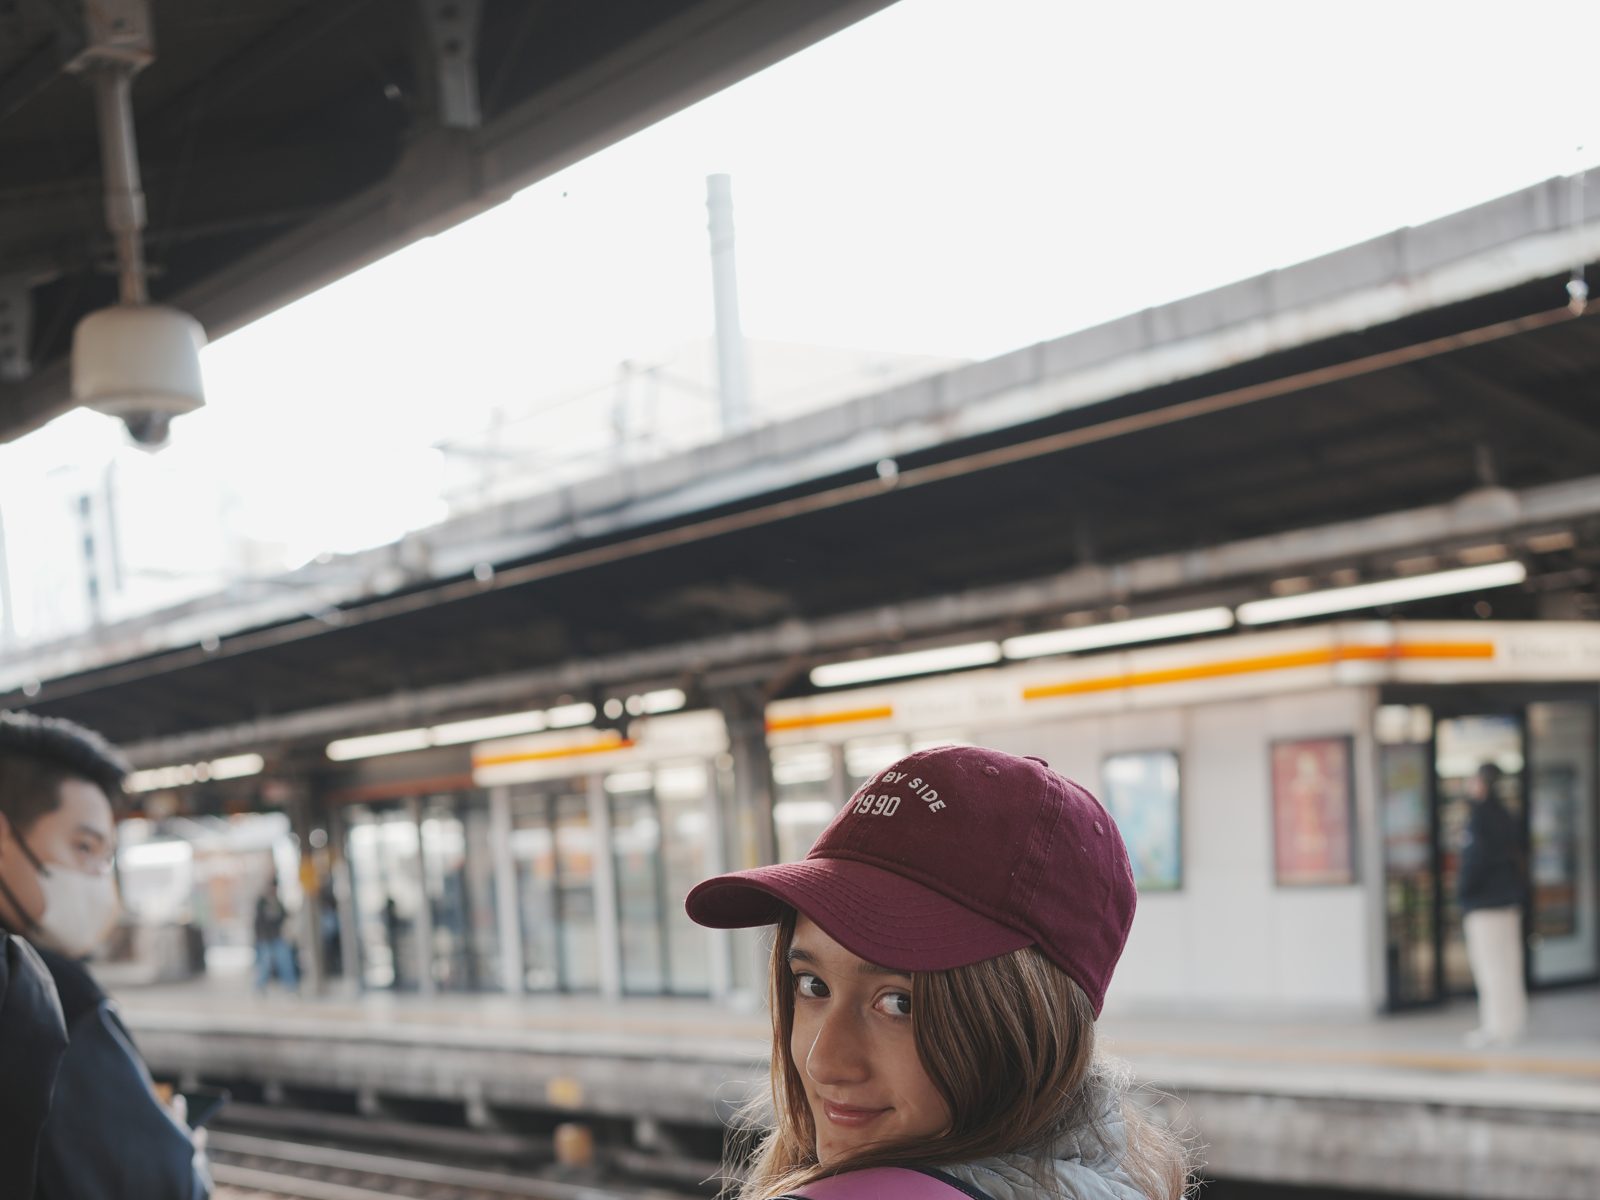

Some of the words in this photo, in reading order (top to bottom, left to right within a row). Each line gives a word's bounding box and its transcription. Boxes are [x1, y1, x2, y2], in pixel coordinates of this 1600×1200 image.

[852, 794, 901, 817] 1990
[881, 771, 908, 784] BY
[908, 777, 947, 814] SIDE
